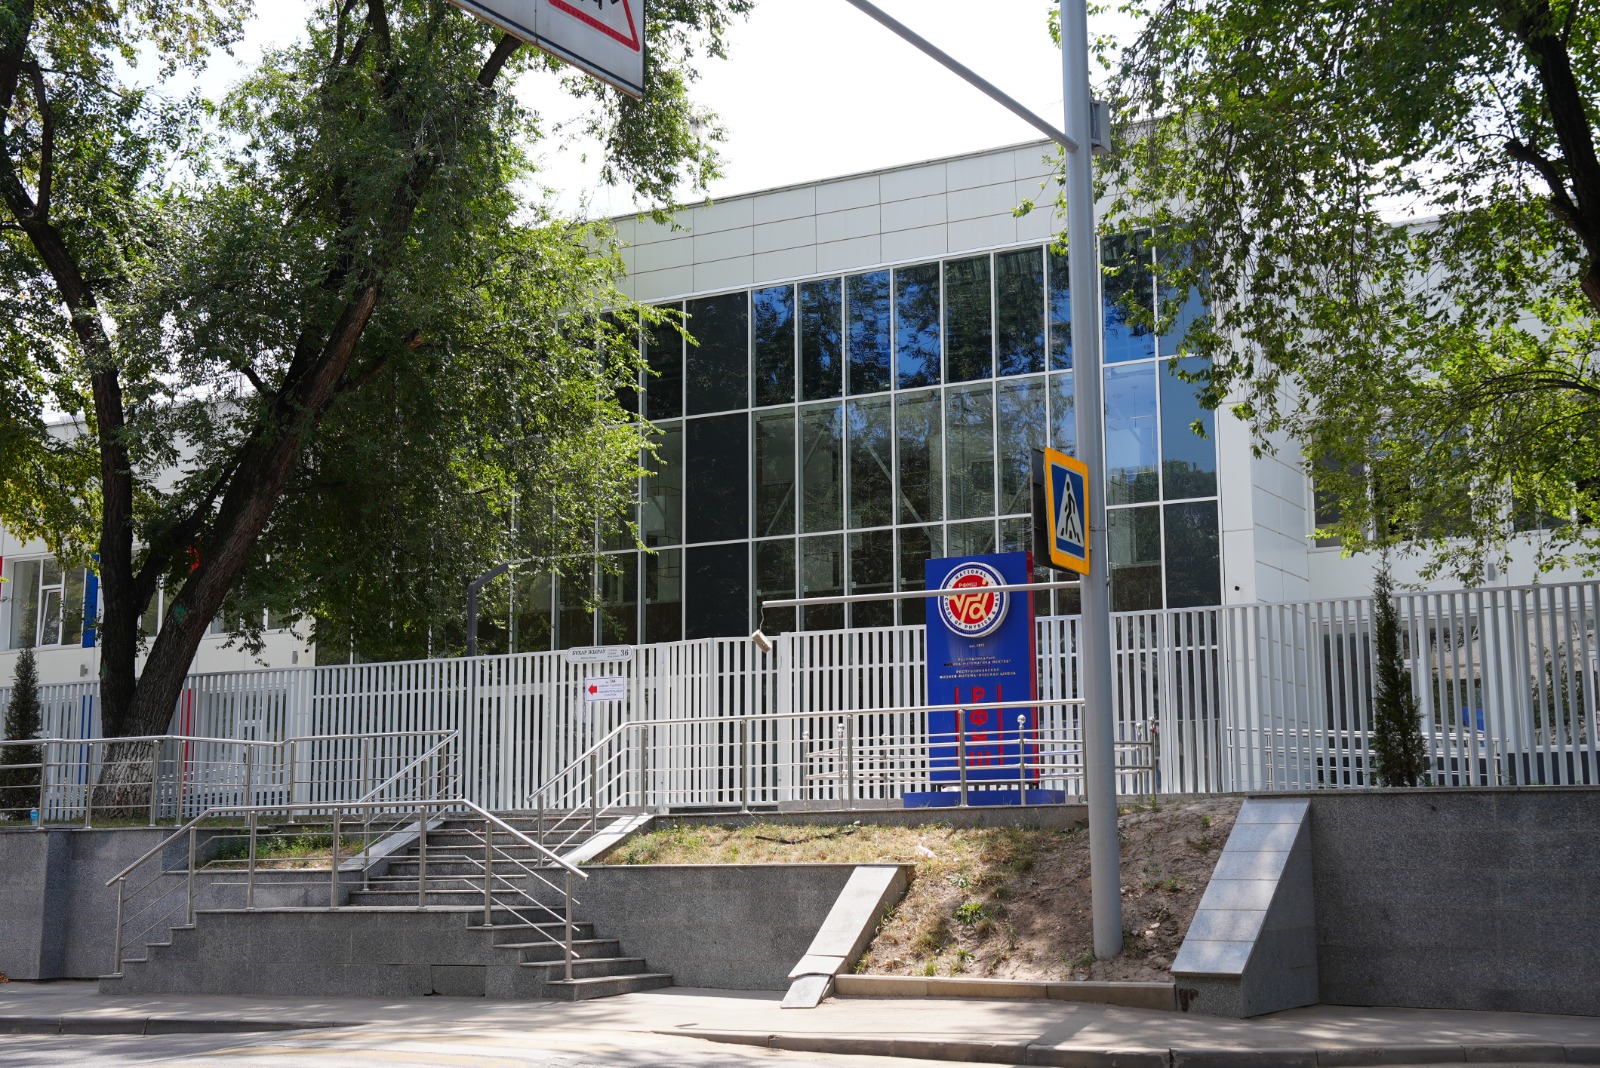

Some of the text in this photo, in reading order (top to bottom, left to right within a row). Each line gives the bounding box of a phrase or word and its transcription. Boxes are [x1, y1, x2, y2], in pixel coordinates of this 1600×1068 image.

[955, 569, 986, 579] NATIONAL
[964, 617, 992, 630] PHYSICS
[970, 686, 990, 767] РФМШ
